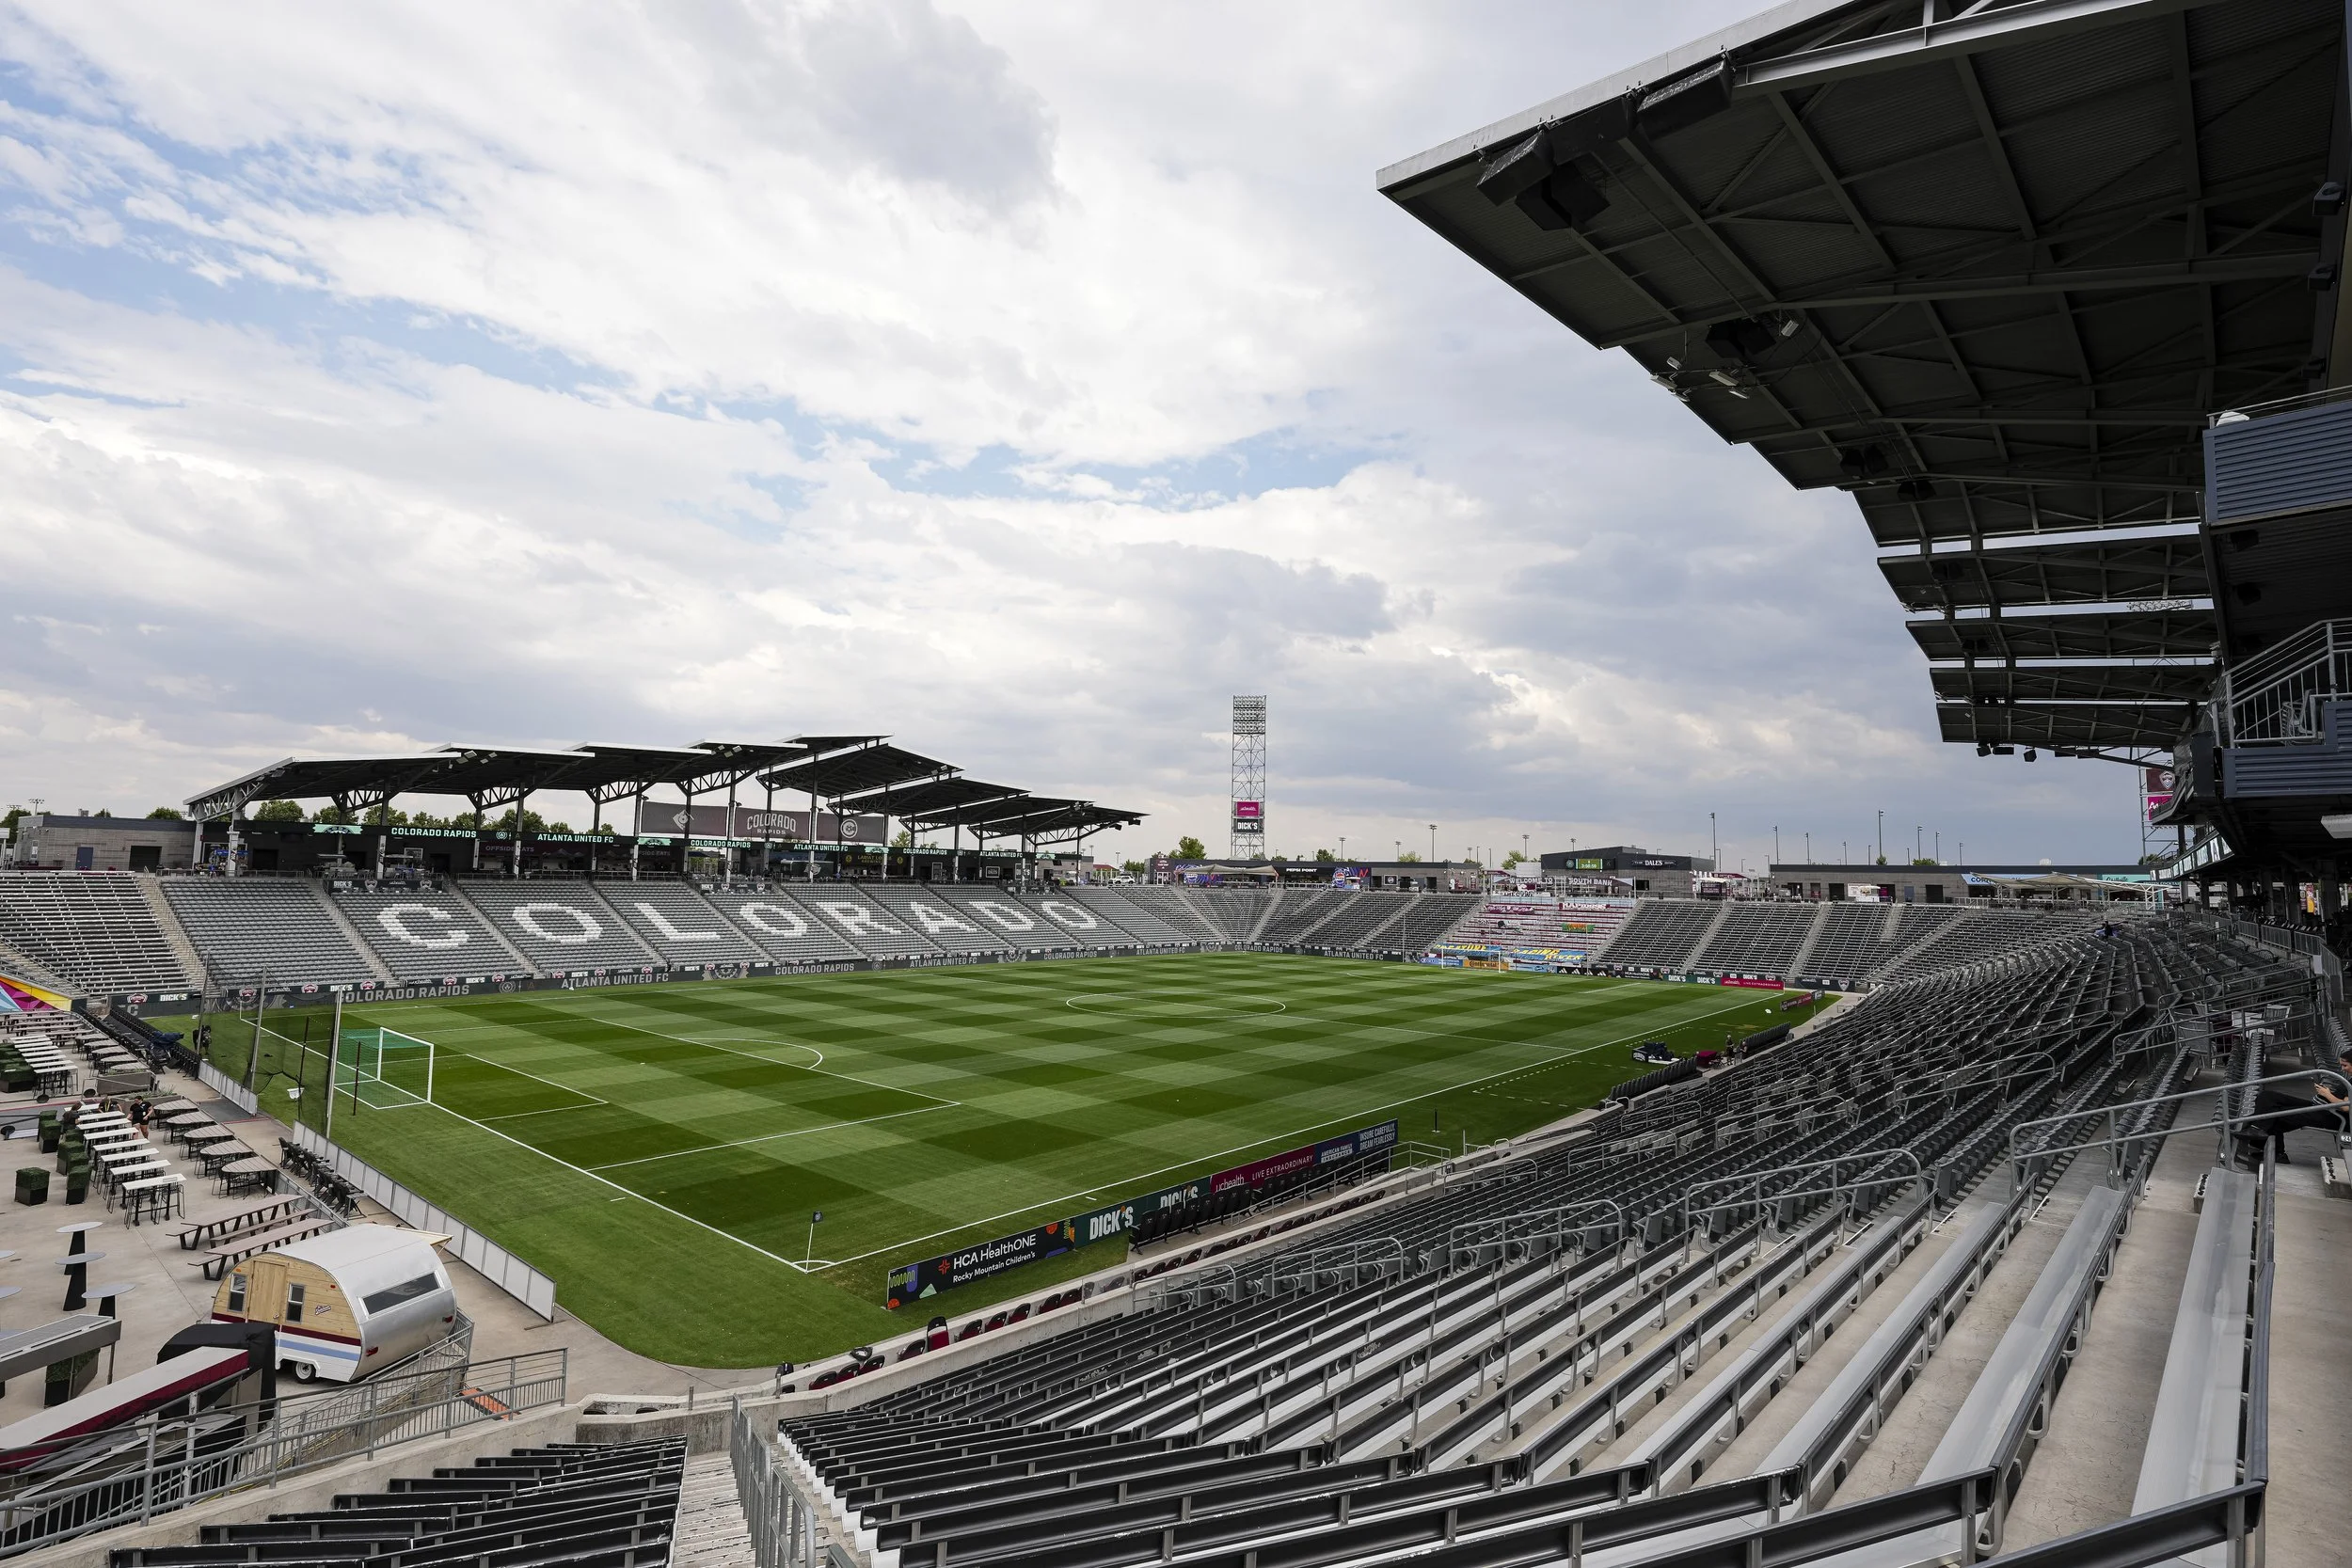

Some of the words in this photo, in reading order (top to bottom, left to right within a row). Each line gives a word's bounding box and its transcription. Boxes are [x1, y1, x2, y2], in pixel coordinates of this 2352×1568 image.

[747, 814, 796, 832] COLORADO
[1237, 821, 1258, 831] DICK'S
[390, 827, 441, 837] COLORADO
[443, 830, 477, 838] RAPIDS
[537, 833, 573, 843] ATLANTA
[574, 835, 602, 844] UNITED
[334, 880, 353, 889] DICK'S
[1509, 877, 1541, 885] WELCOME
[1568, 877, 1592, 885] SOUTH
[377, 900, 1099, 950] COLORADO
[1044, 952, 1075, 960] COLORADO
[1262, 945, 1283, 954] RAPIDS
[775, 965, 822, 975] COLORADO
[823, 963, 855, 973] RAPIDS
[910, 958, 942, 968] ATLANTA
[942, 958, 968, 966] UNITED
[562, 976, 611, 989] ATLANTA
[613, 974, 653, 986] UNITED
[656, 973, 669, 983] FC
[1668, 974, 1687, 983] DICK'S
[1696, 976, 1716, 985] DICK'S
[160, 993, 188, 1002] DICK'S
[419, 984, 470, 999] RAPIDS
[1359, 1129, 1375, 1142] INSURE
[1374, 1123, 1395, 1138] CAREFULLY
[1359, 1139, 1374, 1151] DREAM
[1374, 1132, 1396, 1146] FEARLESSLY
[1320, 1148, 1353, 1164] INSURANCE
[1321, 1146, 1340, 1157] AMERICAN
[1340, 1143, 1353, 1151] FAMILY
[1251, 1169, 1265, 1180] LIVE
[1266, 1155, 1314, 1176] EXTRAORDINARY
[1216, 1174, 1246, 1193] uchealth
[1089, 1206, 1134, 1241] DICK'S
[953, 1252, 979, 1271] HCA
[979, 1233, 1037, 1261] HealthONE
[953, 1263, 974, 1284] Rocky
[974, 1260, 1005, 1277] Mountain
[1005, 1250, 1036, 1267] Children's
